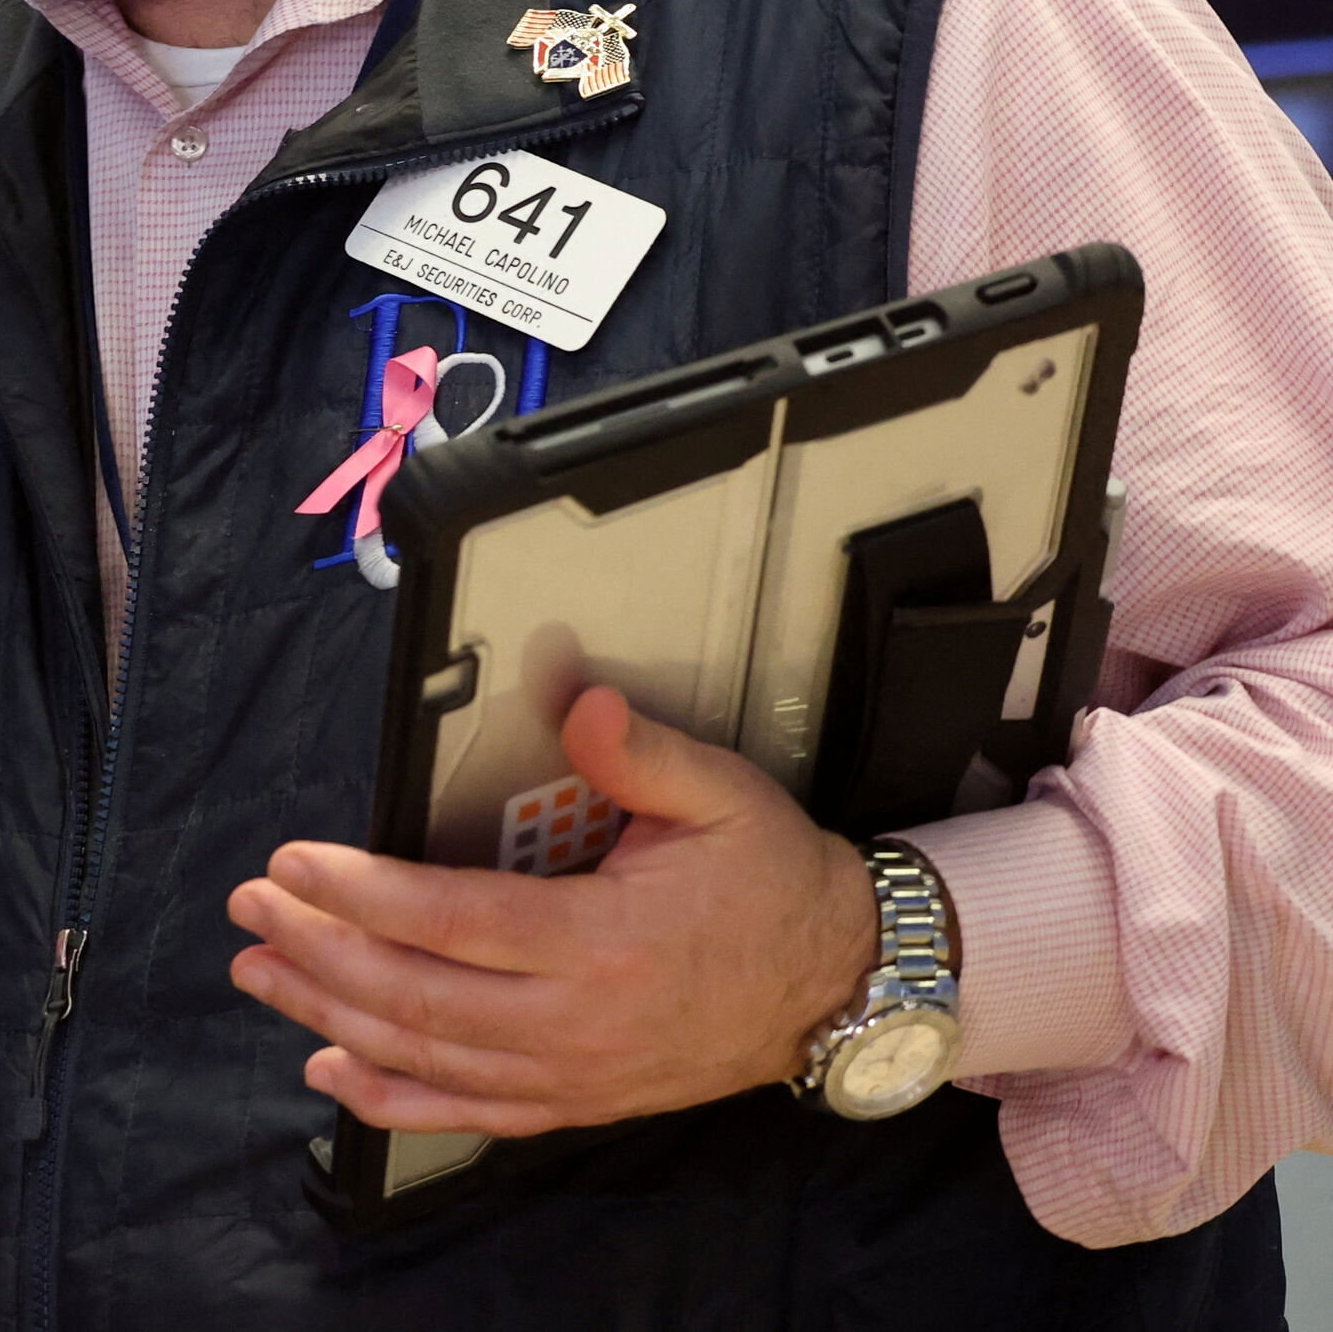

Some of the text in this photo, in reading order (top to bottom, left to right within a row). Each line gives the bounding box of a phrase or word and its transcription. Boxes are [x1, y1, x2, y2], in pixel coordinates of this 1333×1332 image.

[451, 162, 593, 260] 641
[382, 248, 543, 329] E&J SECURITIES CORP.
[403, 214, 570, 295] MICHAEL CAPOLINO
